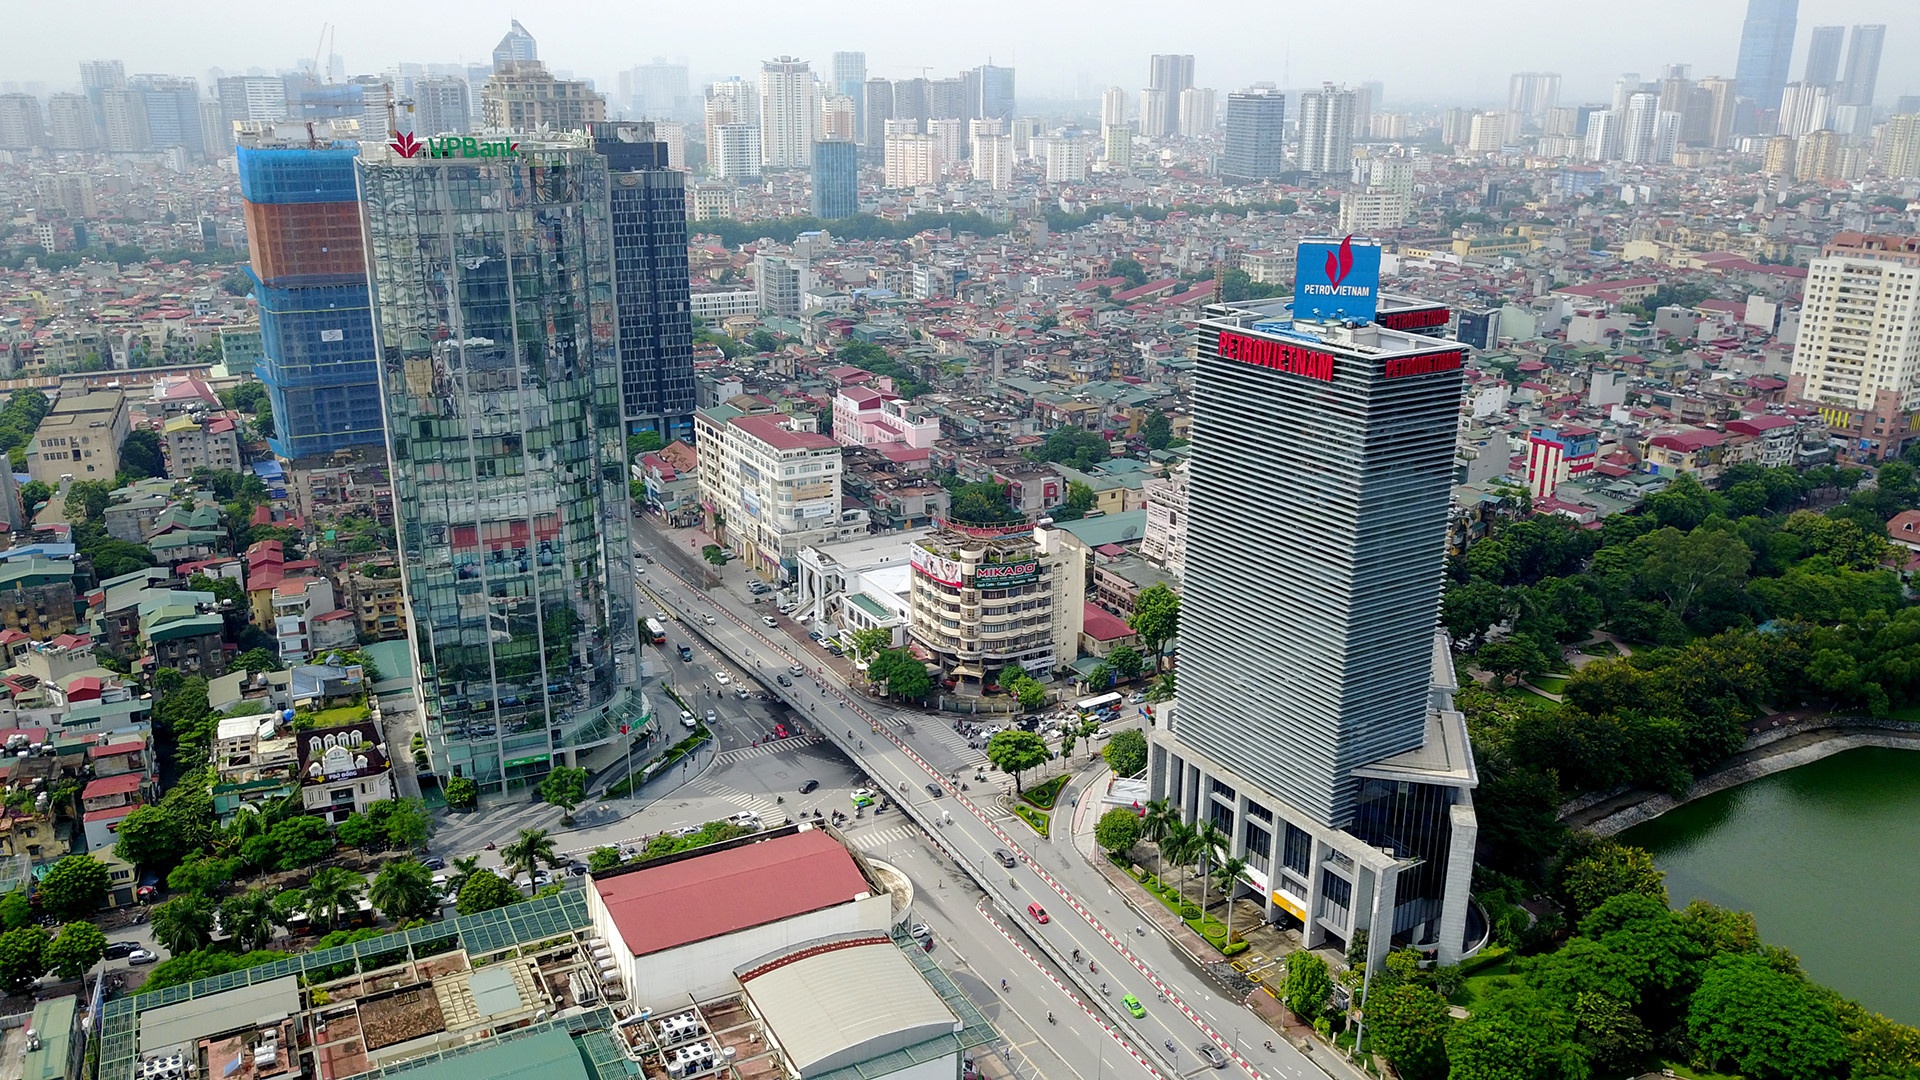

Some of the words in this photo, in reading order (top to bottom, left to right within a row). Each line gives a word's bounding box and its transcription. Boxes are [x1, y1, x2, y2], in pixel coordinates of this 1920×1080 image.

[427, 136, 520, 159] VPBank
[1304, 284, 1370, 297] PETROVIETNAM
[1386, 309, 1450, 330] PETROVIETNAM
[1218, 331, 1334, 382] PETROVIETNAM
[1385, 351, 1462, 378] PETROVIETNAM
[976, 563, 1036, 578] MIKADO
